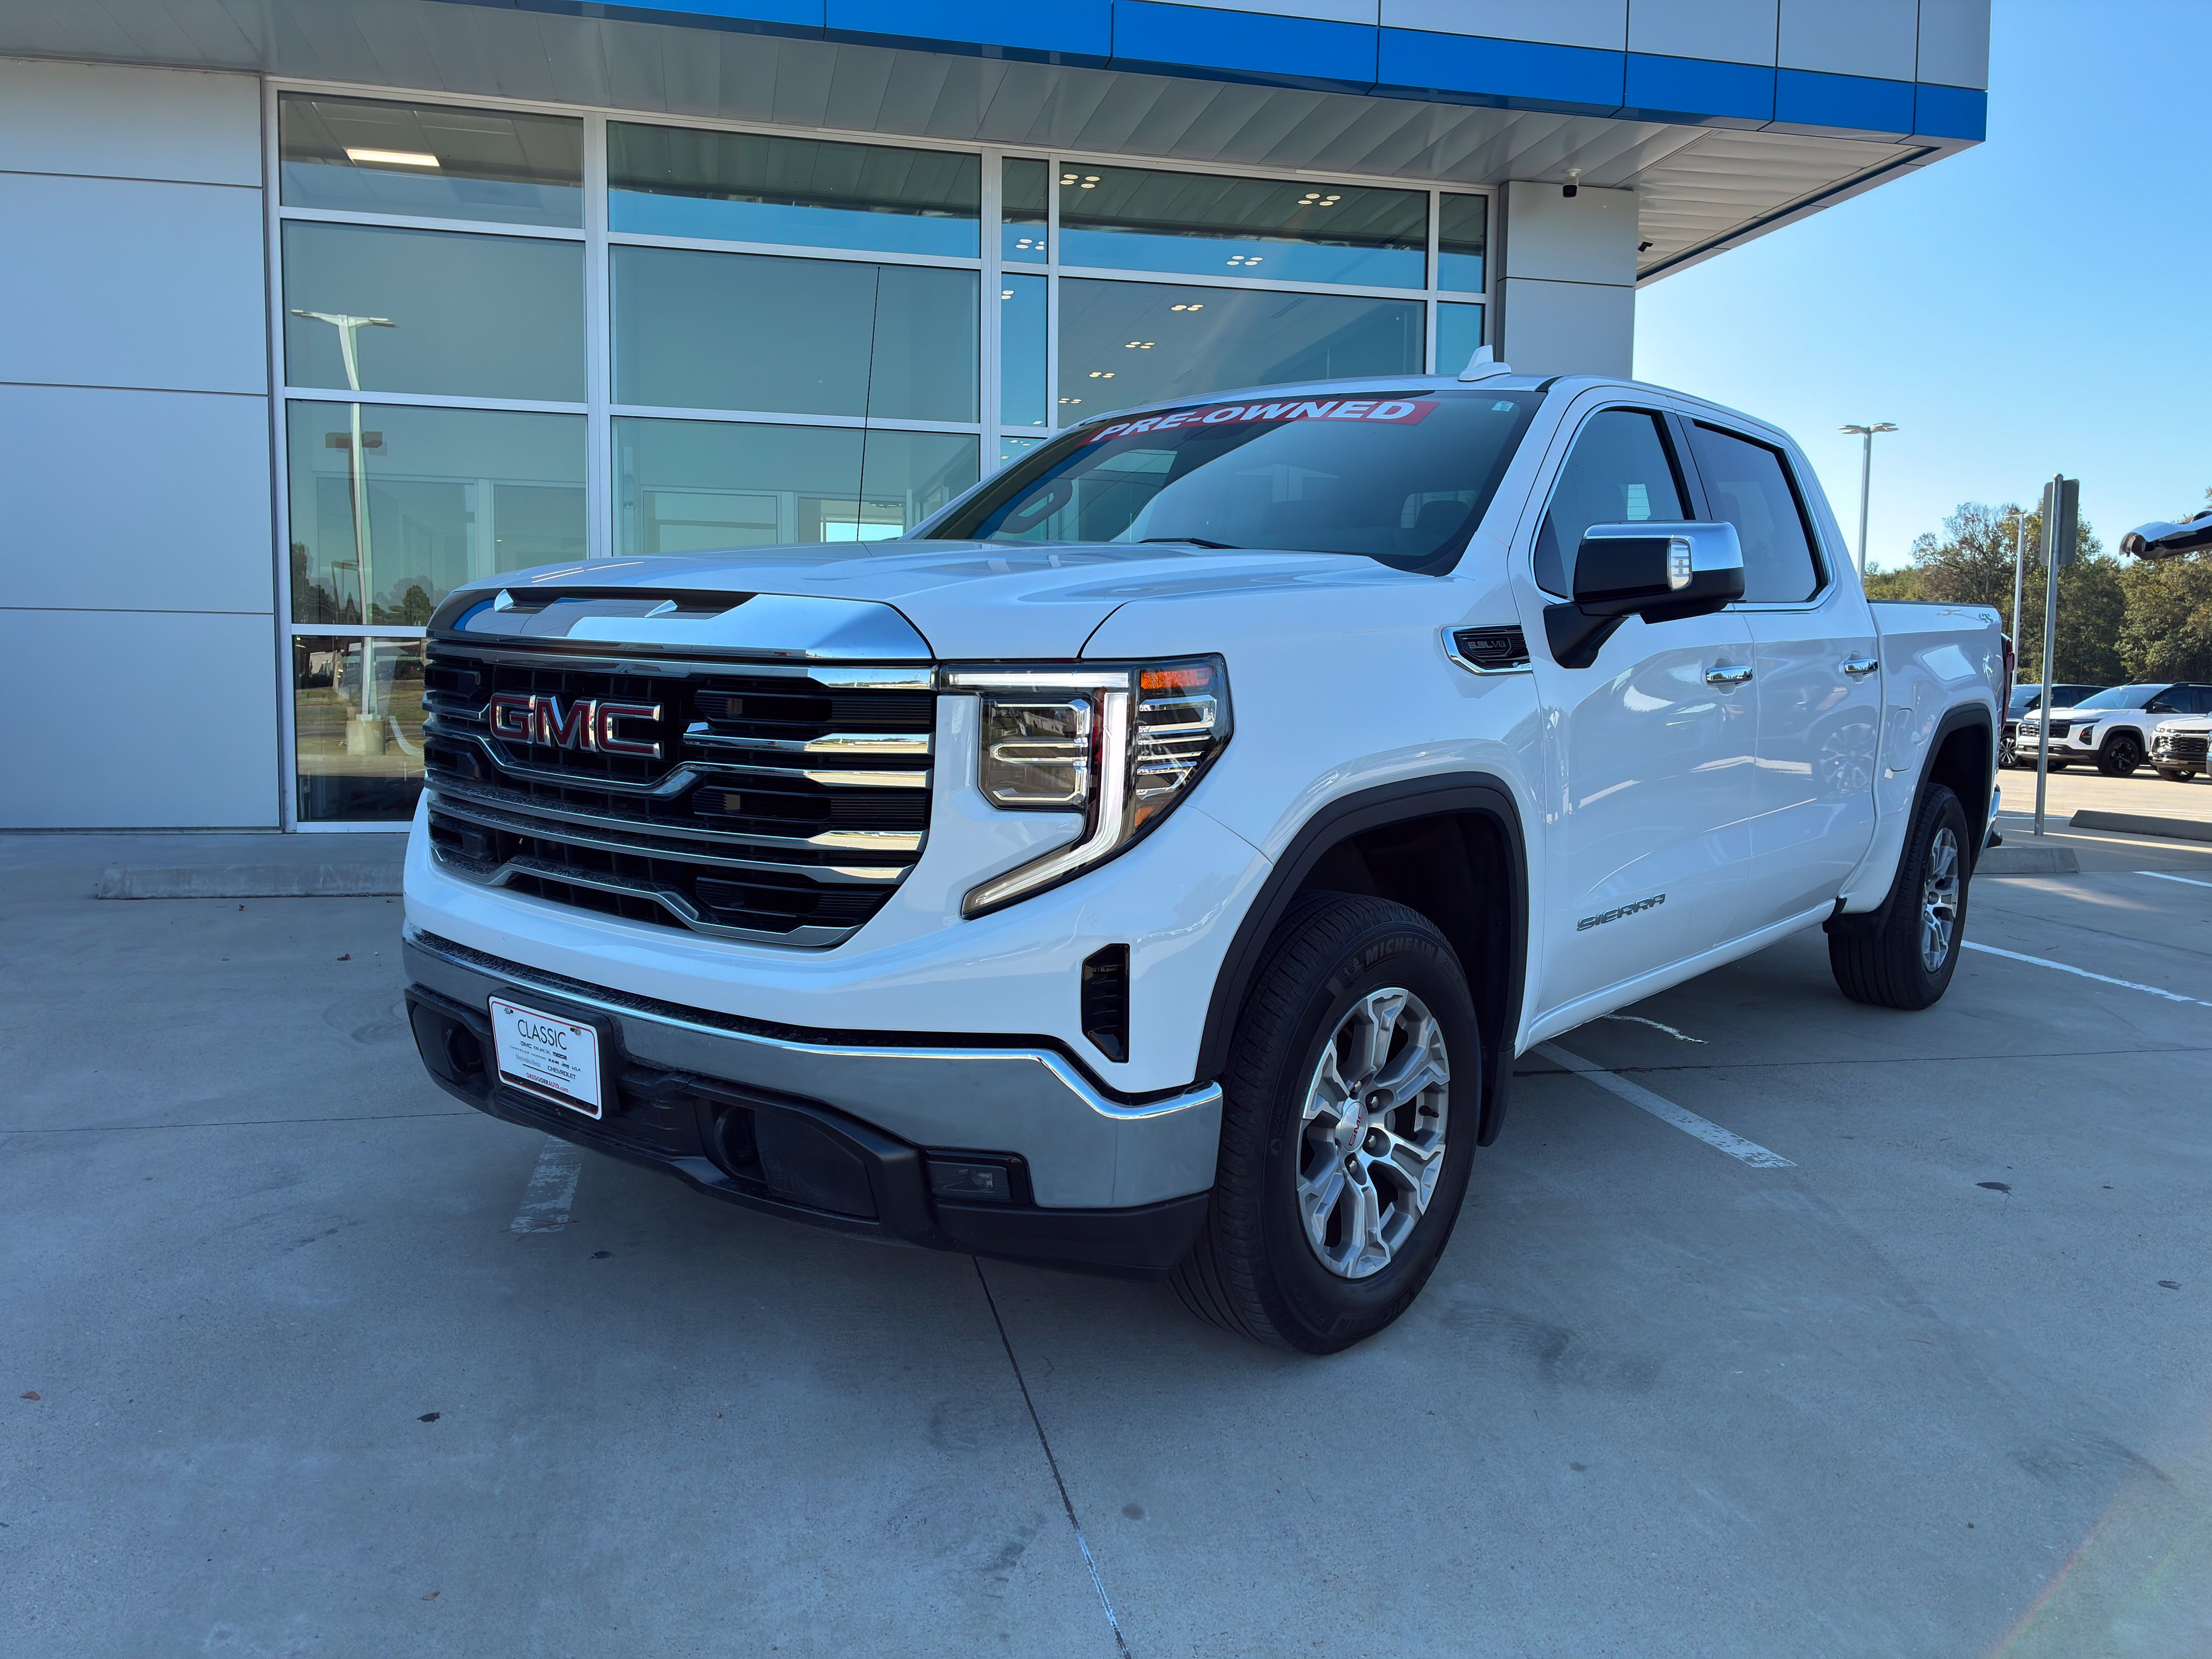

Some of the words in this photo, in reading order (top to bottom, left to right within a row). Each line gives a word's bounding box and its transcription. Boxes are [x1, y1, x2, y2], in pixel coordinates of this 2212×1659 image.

[1089, 401, 1416, 442] PRE-OWNED
[489, 692, 660, 759] GMC
[1576, 893, 1666, 931] SIERRA
[1366, 938, 1435, 967] MICHELIN
[517, 1019, 567, 1050] CLASSIC
[521, 1041, 532, 1049] GMC
[534, 1045, 551, 1055] BUICK
[510, 1045, 530, 1055] CHRYSLER
[561, 1061, 570, 1069] Jeep
[526, 1072, 569, 1093] GREGGORRAUTO.com
[548, 1065, 576, 1080] CHEVROLET
[1348, 1107, 1363, 1146] GMC
